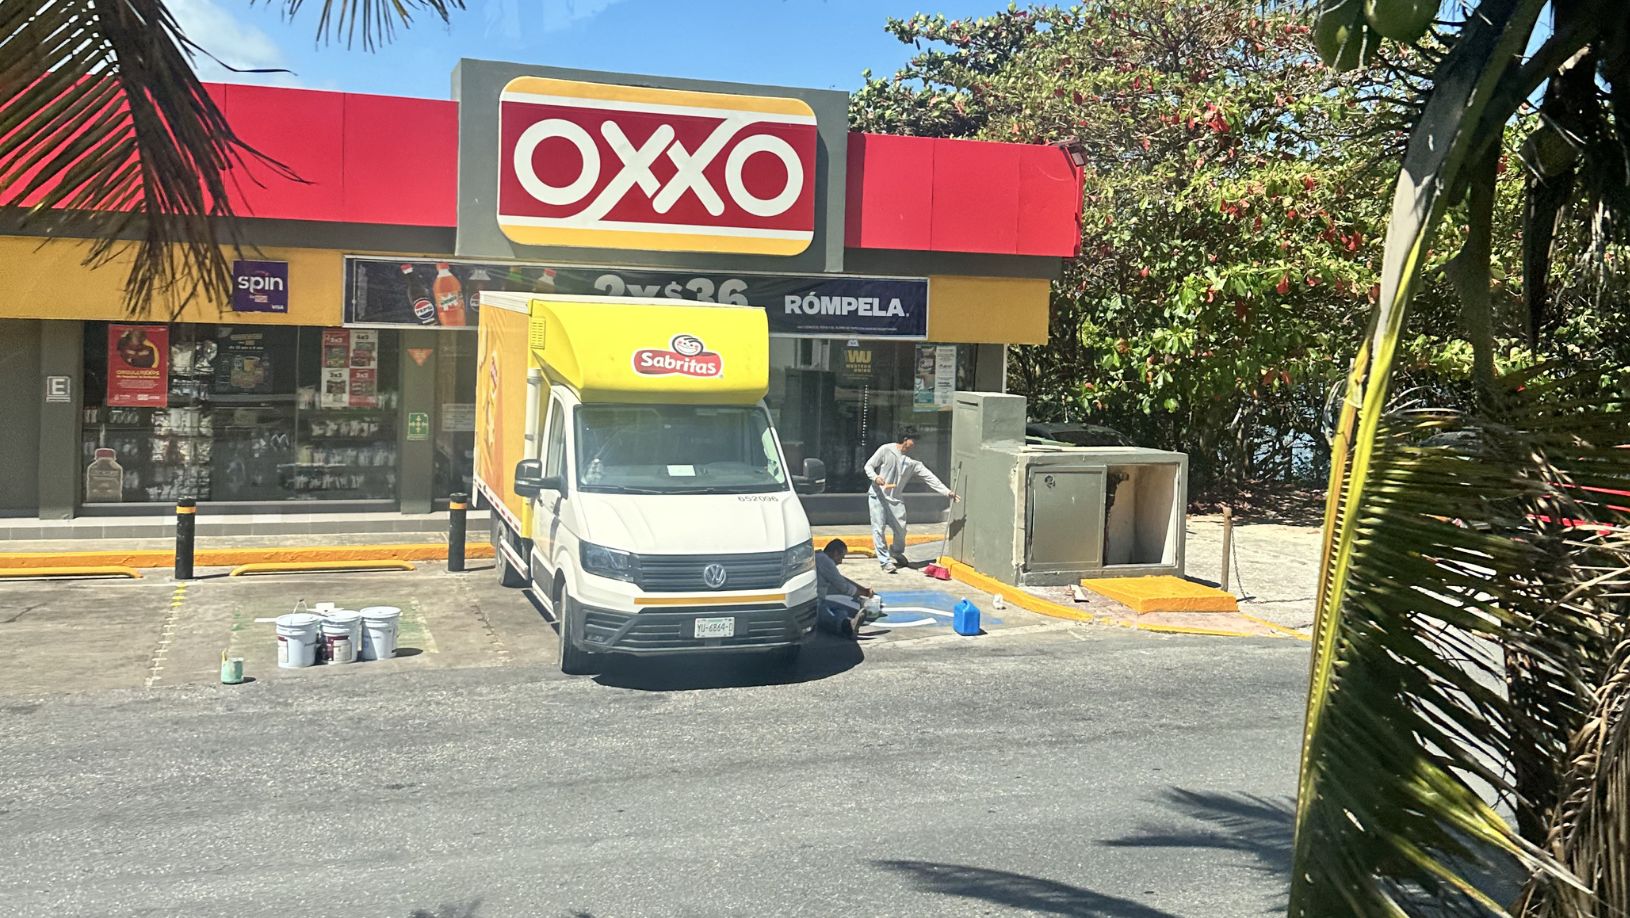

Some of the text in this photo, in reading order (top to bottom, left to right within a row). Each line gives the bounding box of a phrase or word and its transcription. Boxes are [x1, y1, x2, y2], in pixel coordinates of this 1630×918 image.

[514, 118, 804, 223] OXXO
[238, 275, 283, 293] spin
[641, 352, 717, 375] Sabritas
[848, 350, 872, 363] WU
[52, 378, 66, 395] E
